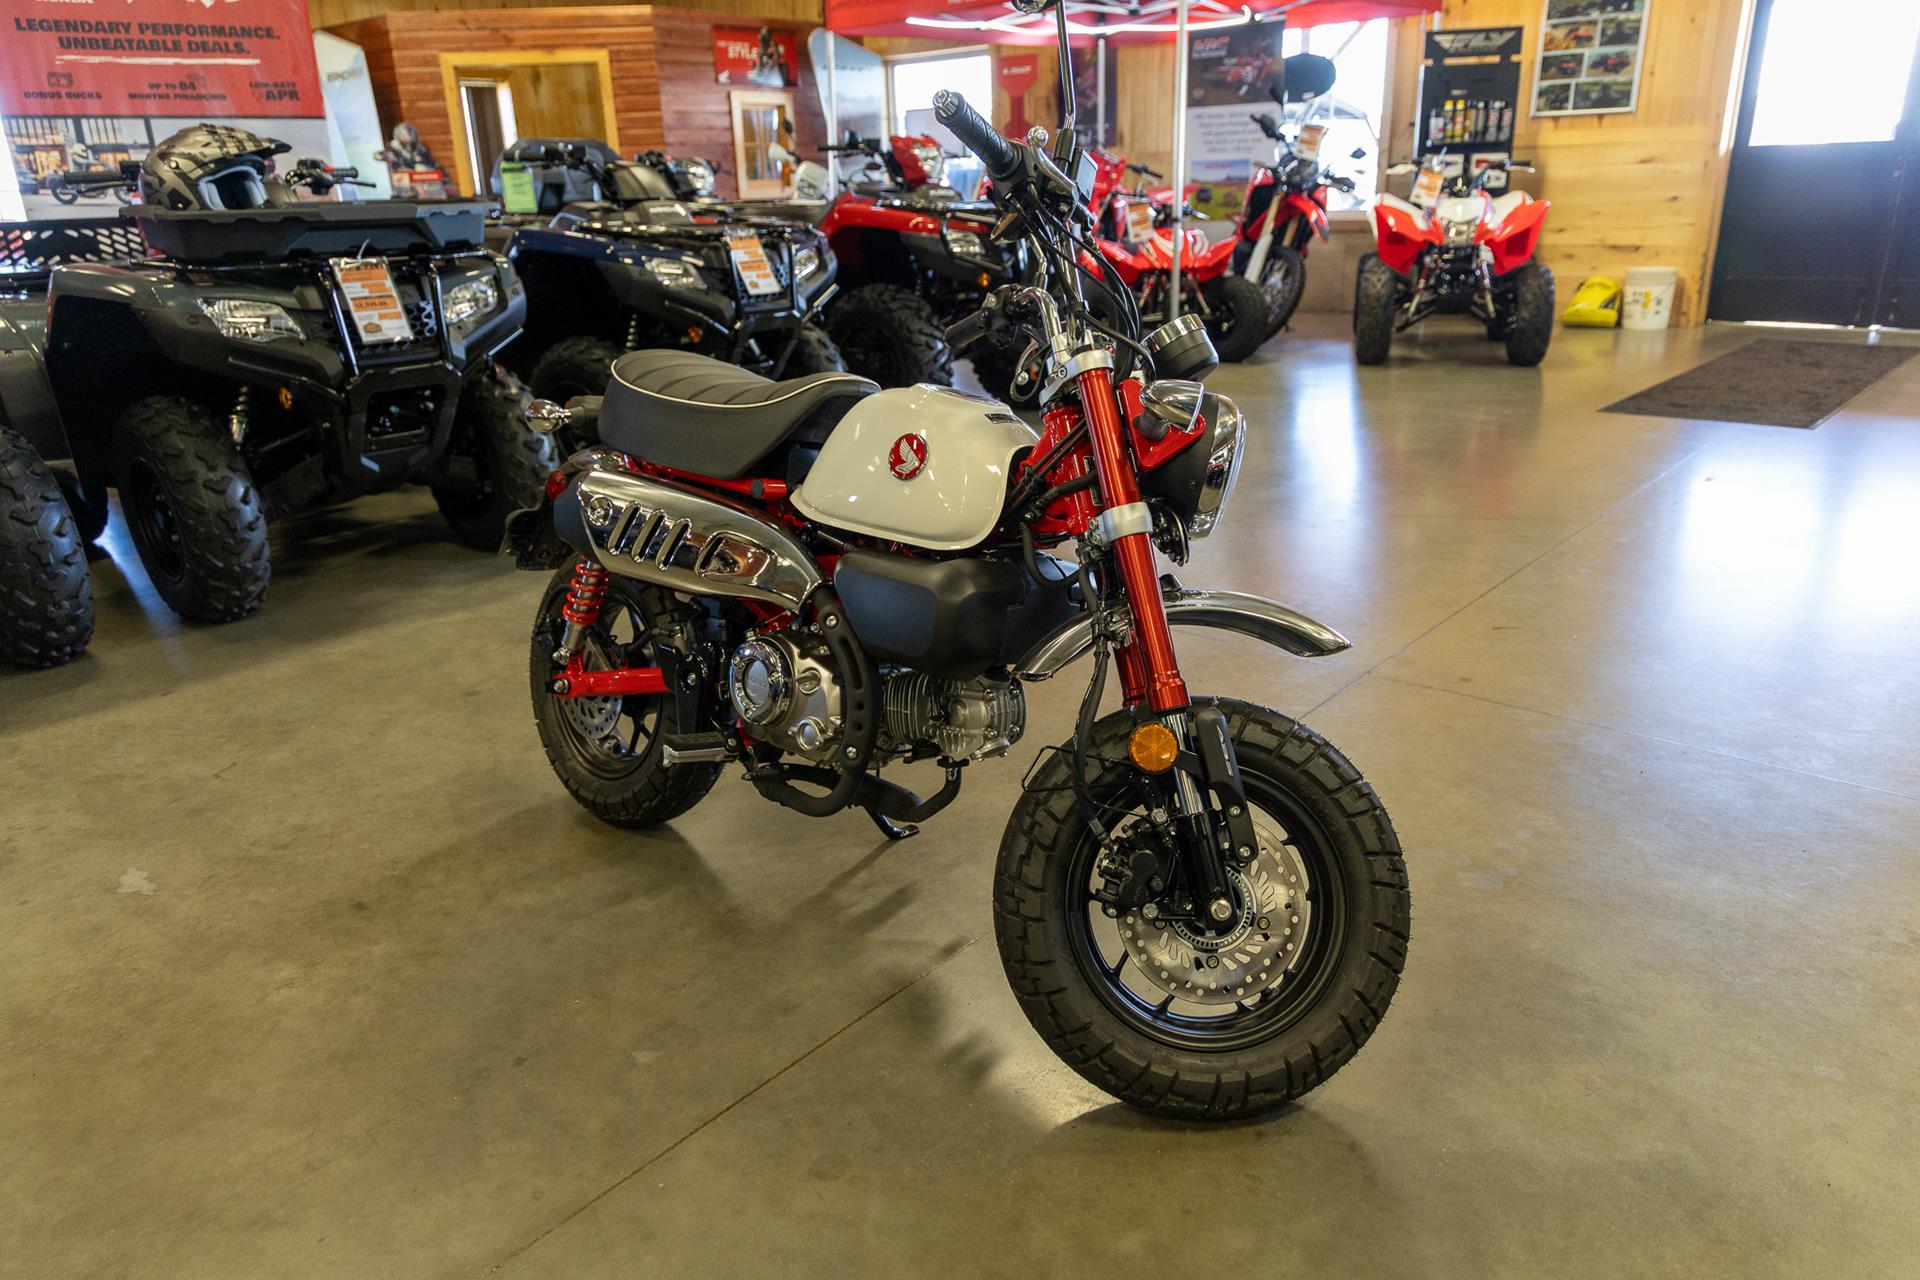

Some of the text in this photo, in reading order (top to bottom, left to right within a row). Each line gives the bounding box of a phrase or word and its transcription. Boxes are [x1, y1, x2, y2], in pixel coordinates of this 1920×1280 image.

[14, 17, 281, 40] LEGENDARY PERFORMANCE.
[58, 36, 251, 54] UNBEATABLE DEALS.
[179, 80, 197, 91] 84
[24, 91, 103, 100] BONUS BUCKS
[174, 93, 227, 101] FINANCING
[265, 90, 300, 101] APR
